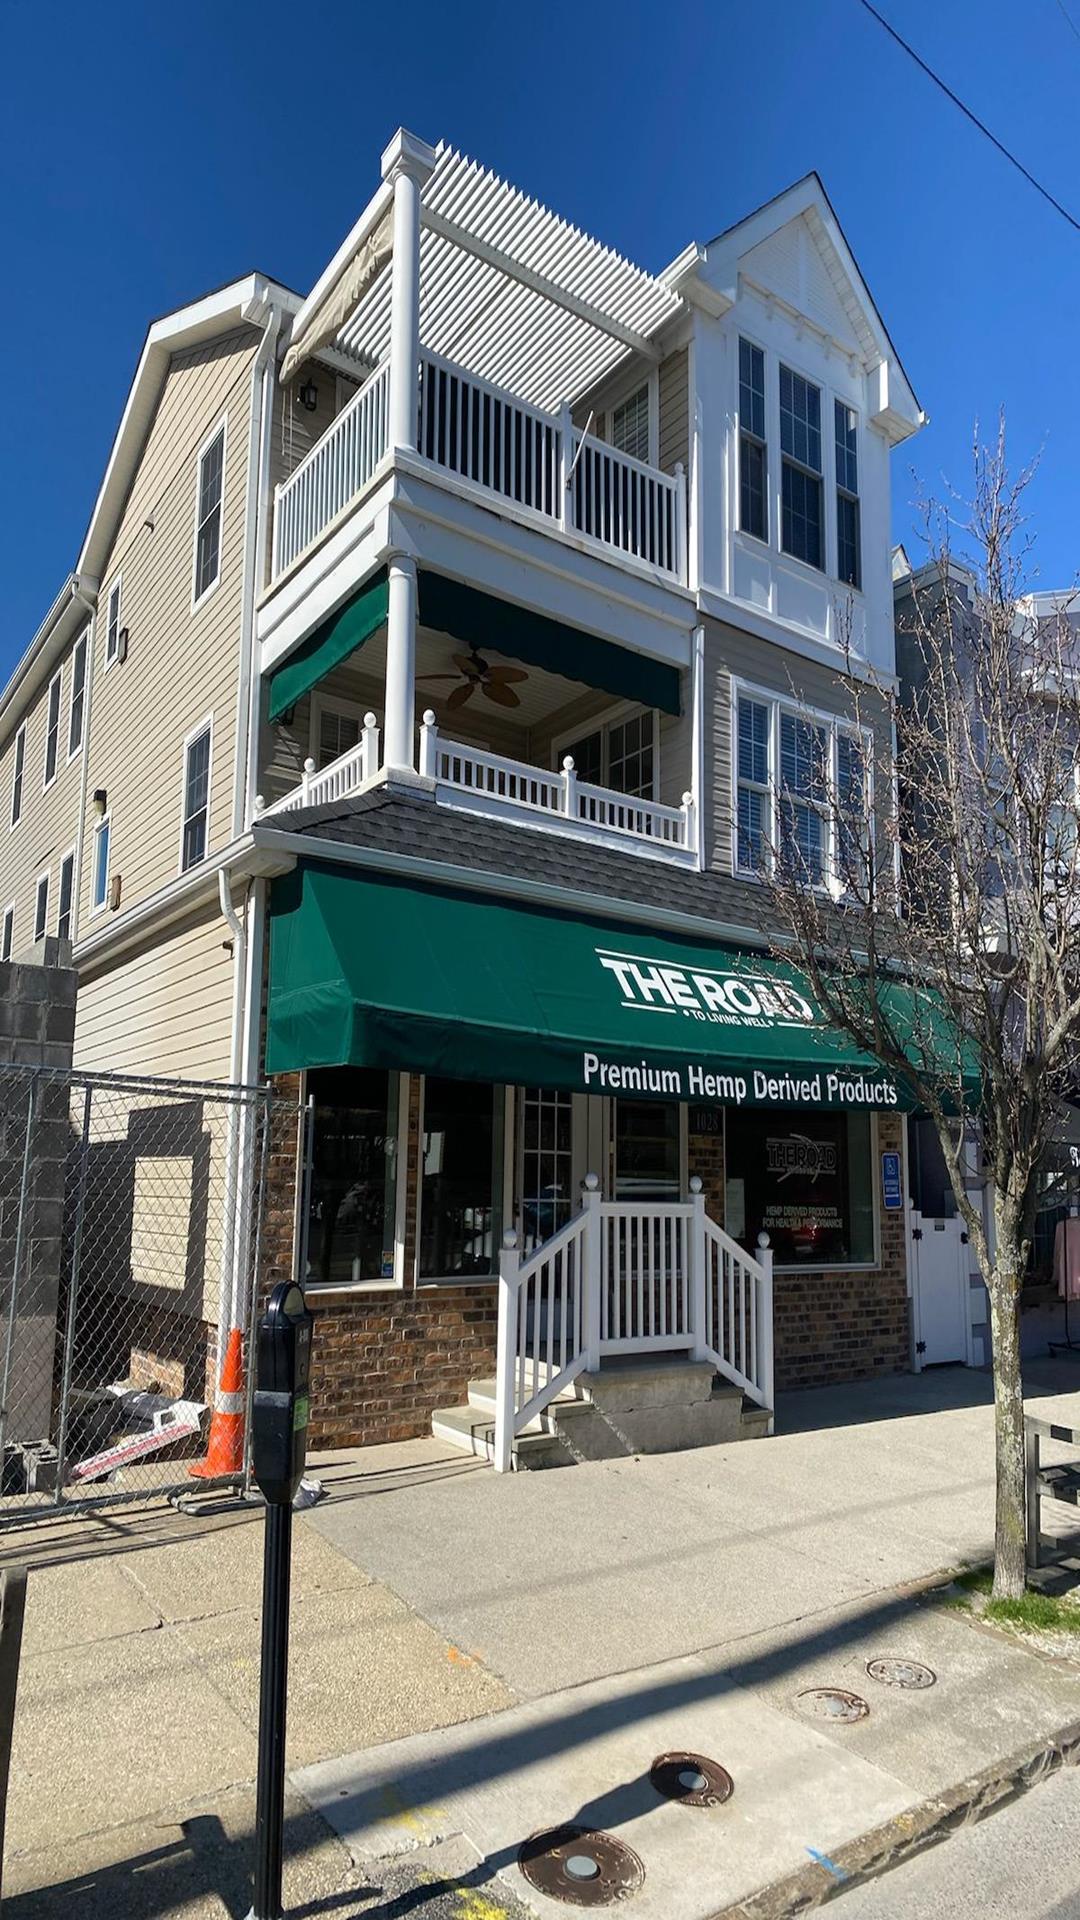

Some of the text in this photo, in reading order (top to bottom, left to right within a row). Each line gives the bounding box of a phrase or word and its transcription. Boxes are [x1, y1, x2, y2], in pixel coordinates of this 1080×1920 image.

[599, 957, 814, 1021] THE ROAD
[690, 1009, 769, 1028] TO LIVING WELL
[583, 1053, 899, 1106] Premium Hemp Derived Products
[766, 1143, 837, 1169] THE ROAD
[763, 1217, 775, 1228] FOR
[766, 1205, 838, 1218] HEMP DERIVED PRODUCTS
